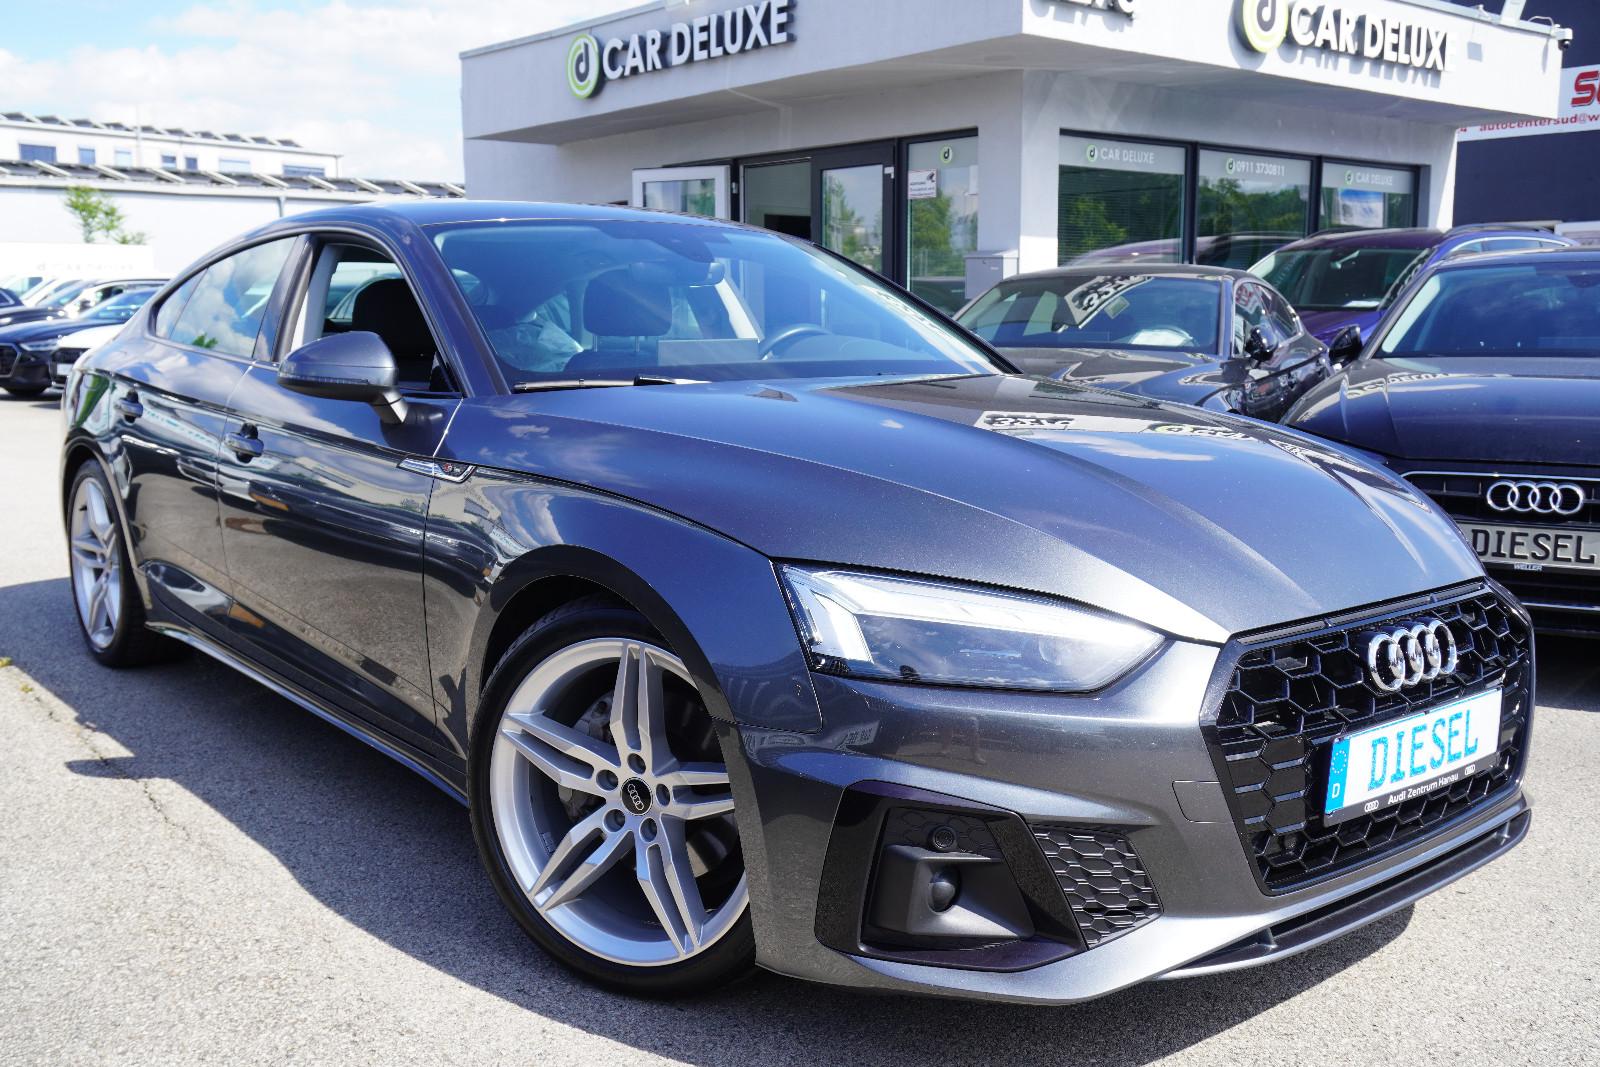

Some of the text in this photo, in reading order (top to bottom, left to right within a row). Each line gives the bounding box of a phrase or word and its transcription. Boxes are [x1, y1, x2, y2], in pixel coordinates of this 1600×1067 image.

[602, 29, 663, 81] CAR
[670, 0, 791, 67] DELUXE
[1290, 2, 1358, 55] CAR
[1100, 147, 1120, 161] CAR
[1122, 150, 1155, 164] DELUXE
[1471, 528, 1596, 564] DIESEL
[1367, 709, 1479, 792] DIESEL
[1331, 782, 1341, 799] D
[1387, 772, 1459, 805] Audi Zentrum Hanau
